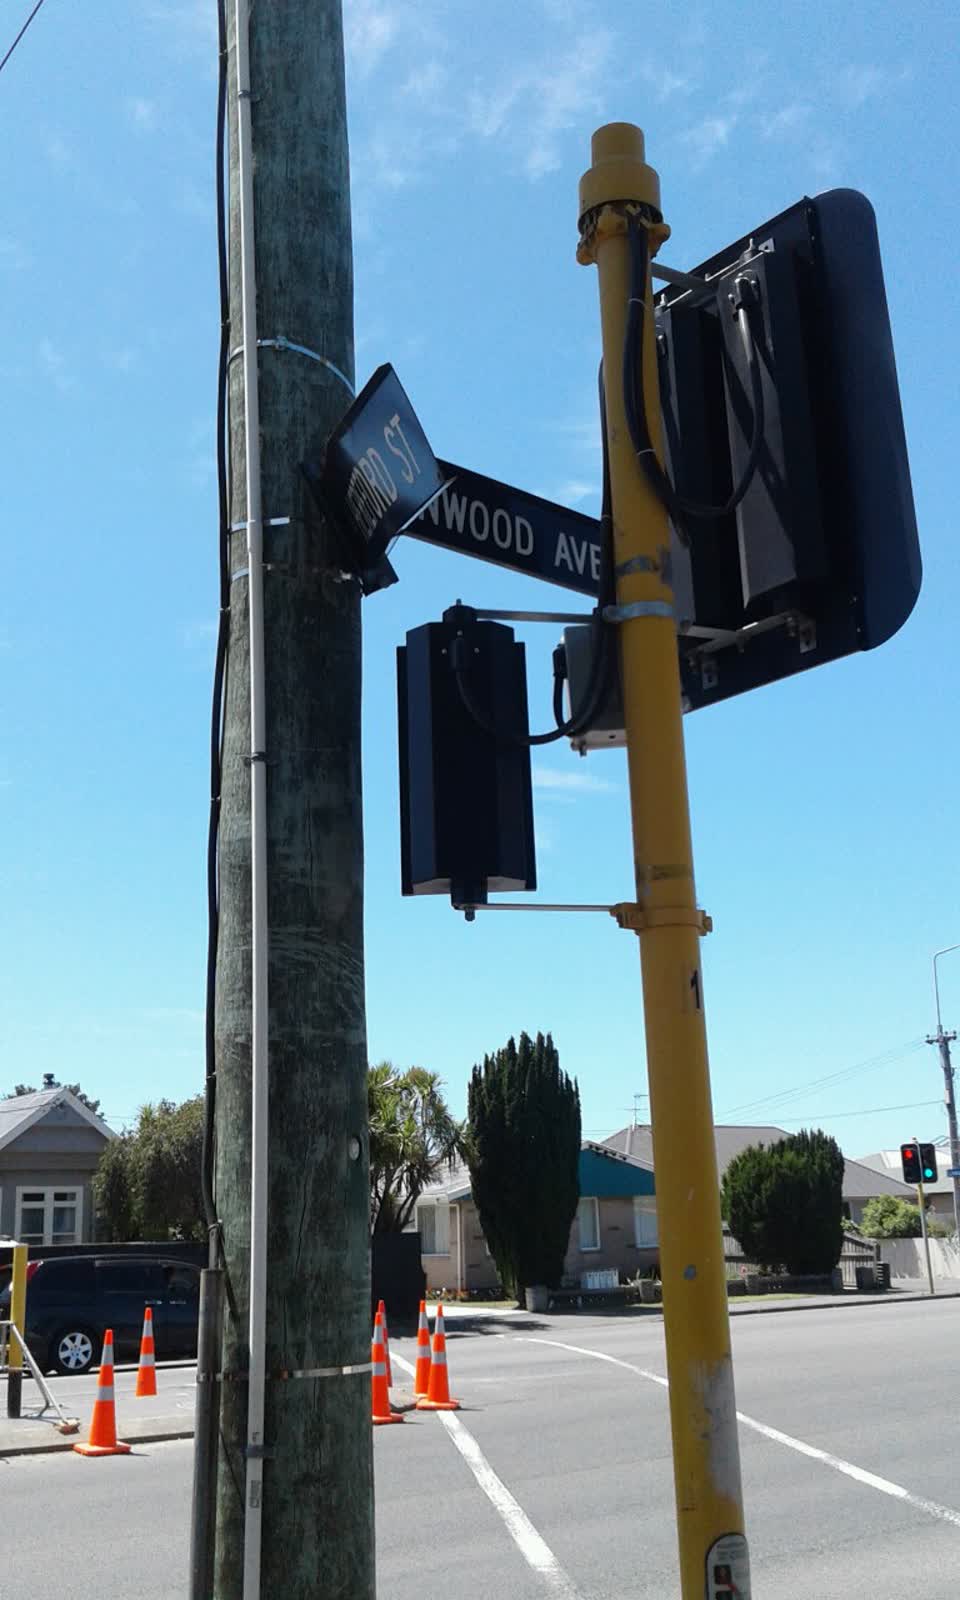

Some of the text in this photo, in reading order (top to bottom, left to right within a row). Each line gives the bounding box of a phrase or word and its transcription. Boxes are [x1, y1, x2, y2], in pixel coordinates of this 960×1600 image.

[384, 413, 421, 483] ST
[554, 532, 600, 581] AVE
[690, 969, 701, 1009] 1
